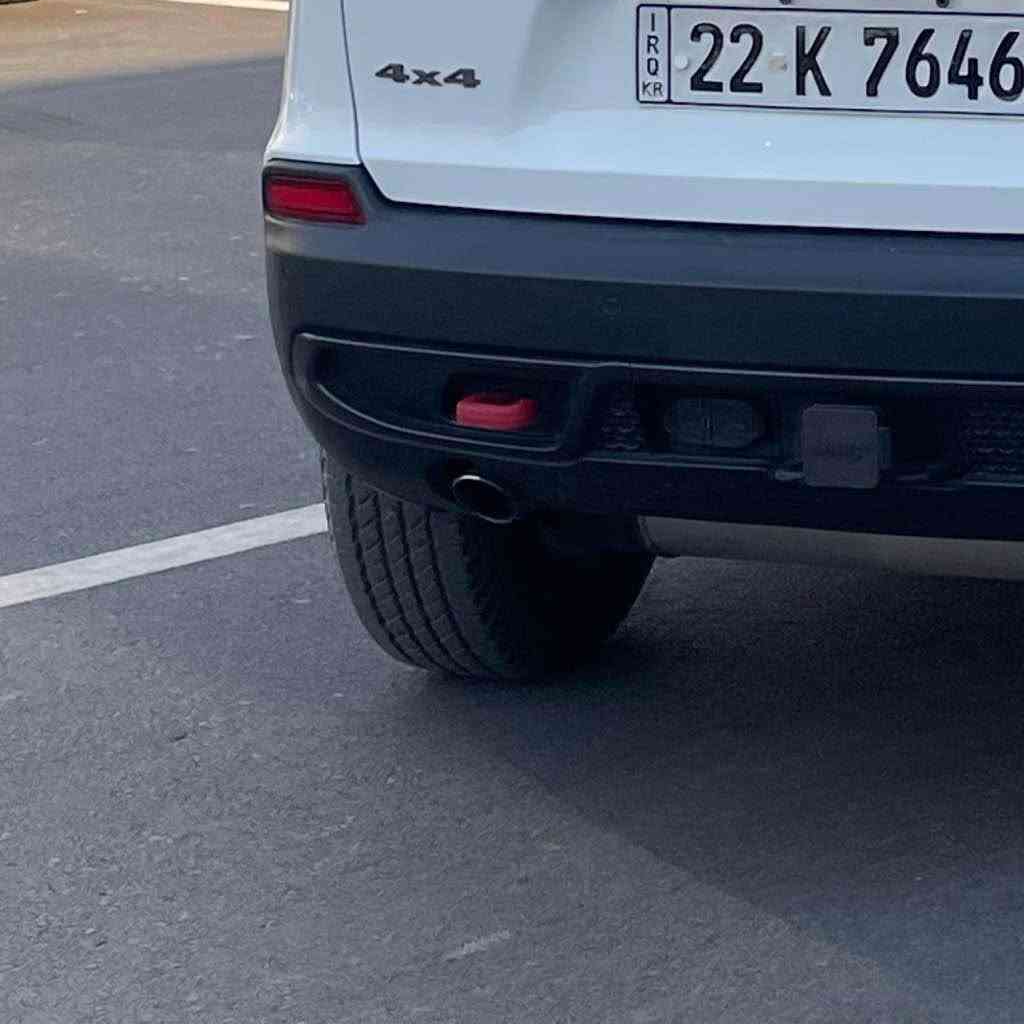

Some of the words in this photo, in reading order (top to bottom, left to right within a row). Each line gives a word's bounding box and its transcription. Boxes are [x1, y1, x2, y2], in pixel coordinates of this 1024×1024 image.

[690, 22, 764, 93] 22
[795, 25, 832, 97] K
[375, 63, 481, 89] 4x4
[641, 80, 663, 97] KR
